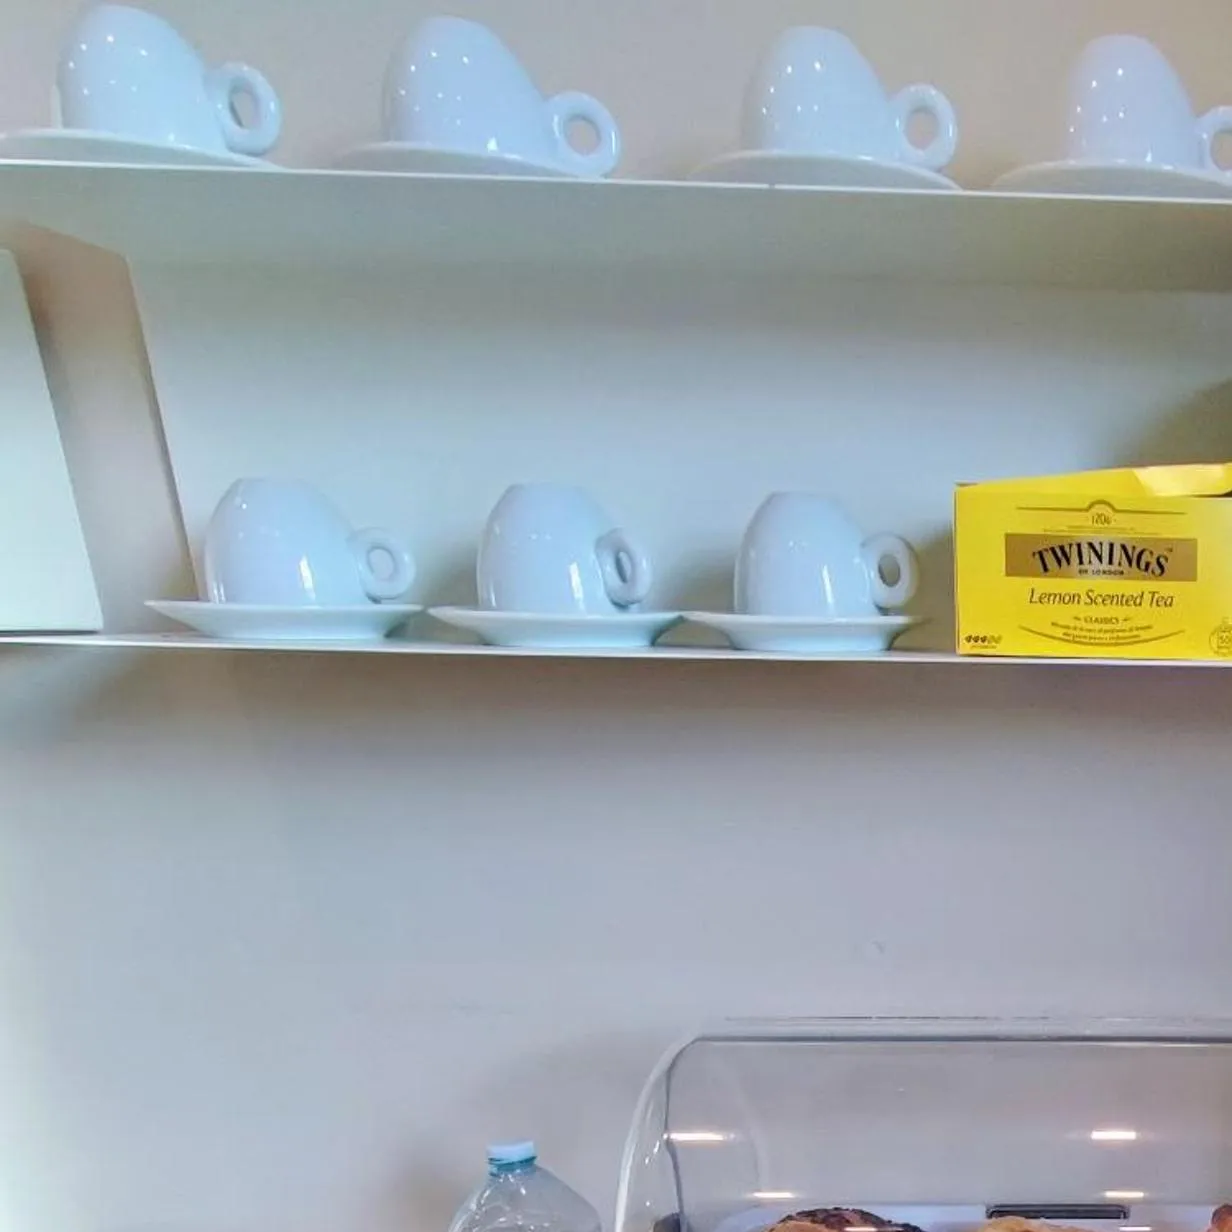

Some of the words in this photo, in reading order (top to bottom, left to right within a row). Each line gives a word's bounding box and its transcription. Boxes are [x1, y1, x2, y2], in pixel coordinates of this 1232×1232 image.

[1032, 541, 1169, 577] TWININGS
[1029, 588, 1081, 606] Lemon
[1084, 589, 1144, 607] Scented
[1148, 591, 1174, 608] Tea
